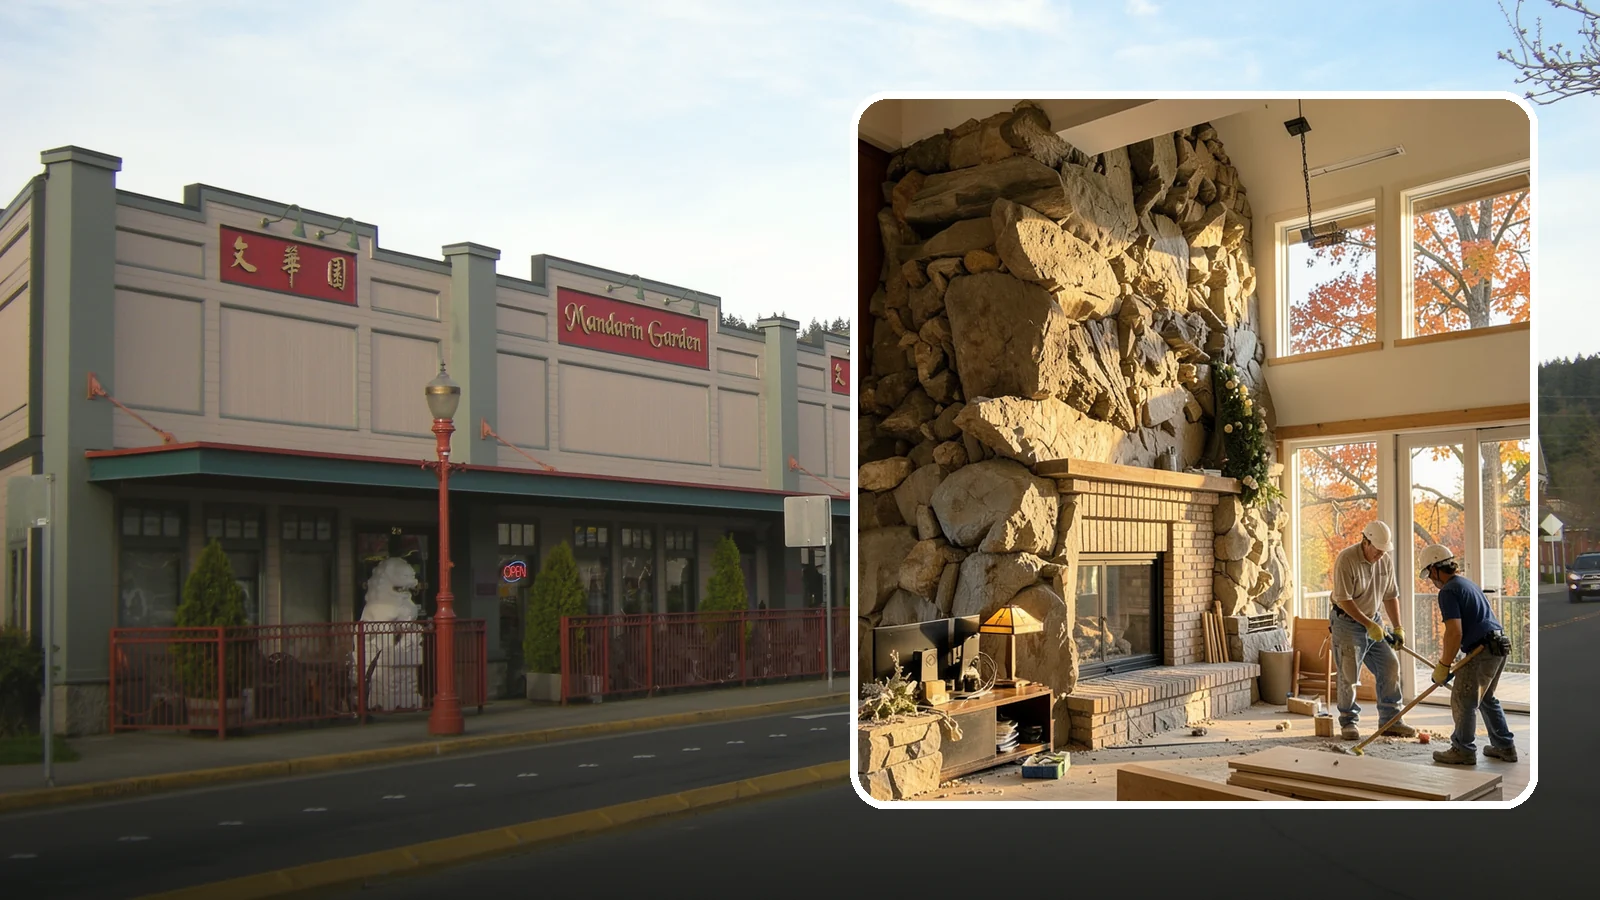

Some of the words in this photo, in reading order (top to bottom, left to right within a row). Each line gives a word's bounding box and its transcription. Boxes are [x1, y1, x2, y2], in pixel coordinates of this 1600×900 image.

[230, 235, 347, 291] 文華園
[564, 302, 644, 341] Mandarin
[647, 320, 702, 353] Garden
[503, 565, 527, 578] OPEN
